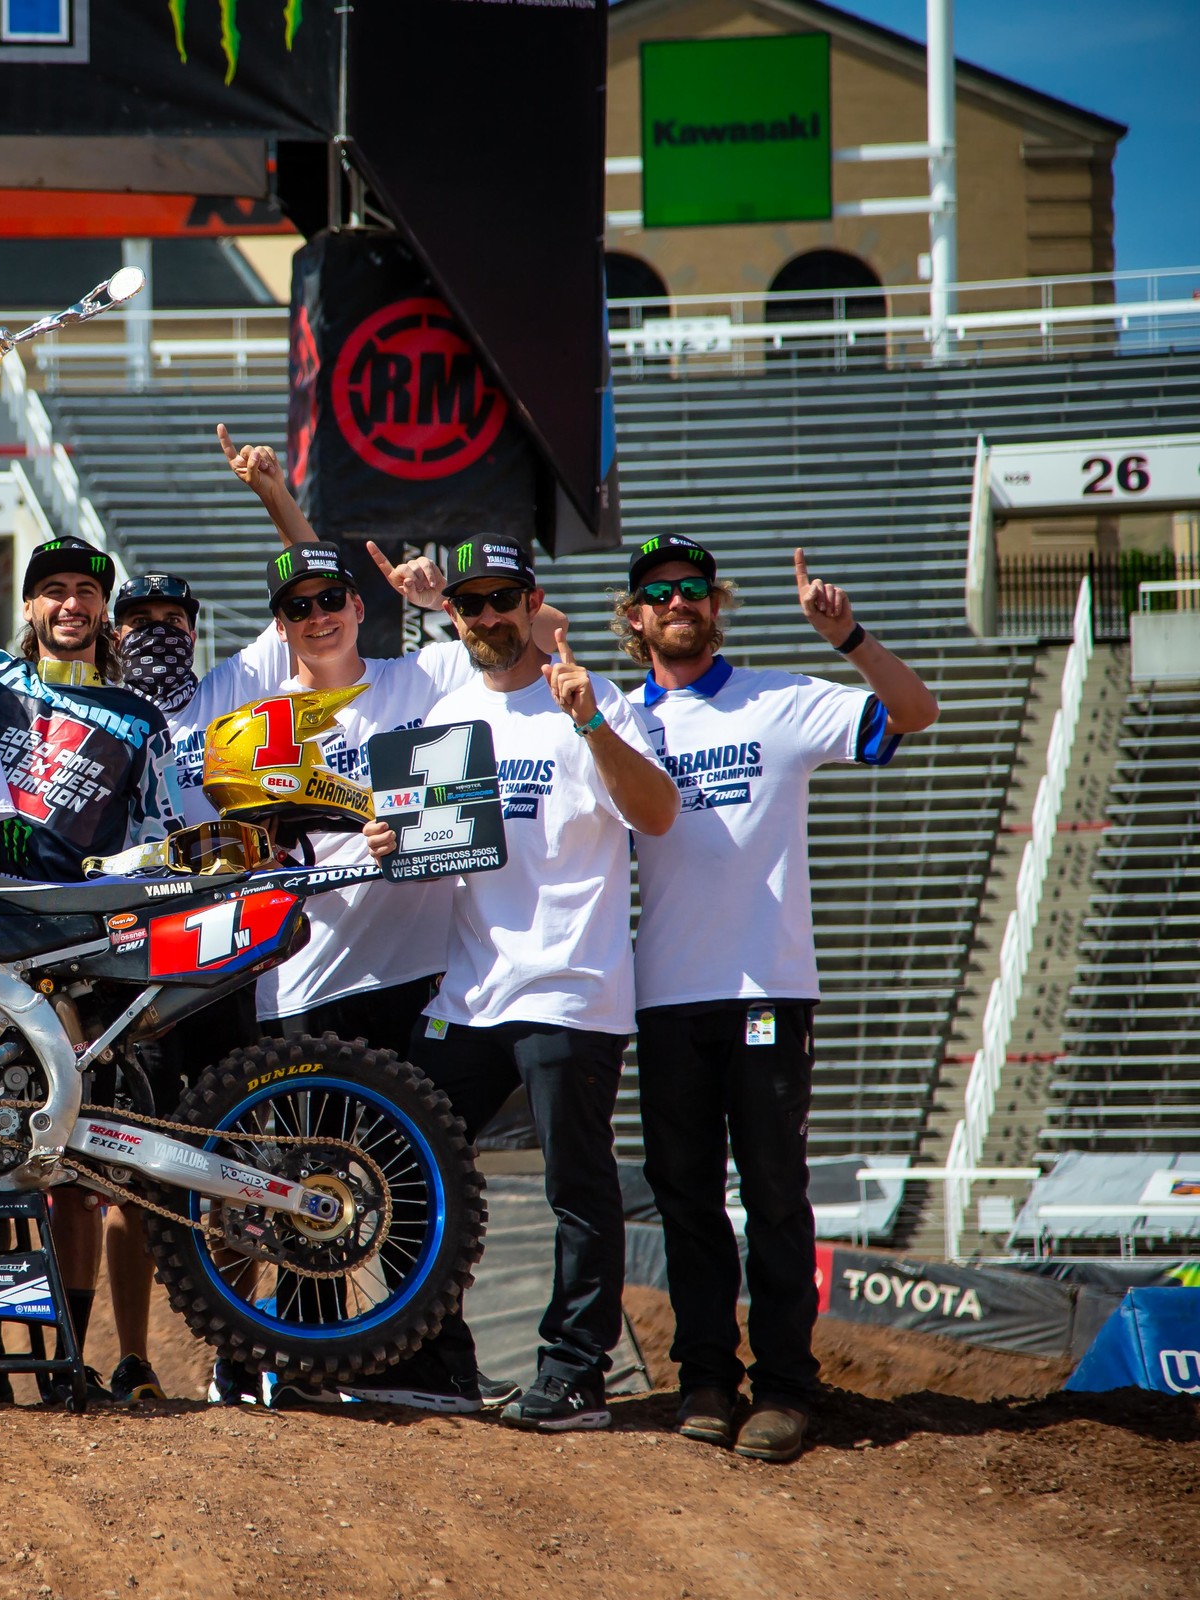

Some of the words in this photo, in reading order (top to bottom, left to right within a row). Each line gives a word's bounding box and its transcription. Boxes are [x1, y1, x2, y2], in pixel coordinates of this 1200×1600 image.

[653, 112, 821, 147] Kawasaki
[369, 352, 476, 426] RM
[1081, 455, 1150, 494] 26
[310, 550, 337, 559] YAMAHA
[492, 545, 518, 557] YAMAHA
[252, 697, 304, 771] 1
[0, 726, 57, 758] 2020
[54, 748, 106, 780] AMA
[324, 741, 348, 754] DYLAN
[176, 755, 188, 767] ST
[663, 741, 762, 777] RRANDIS
[17, 753, 51, 777] SX
[50, 766, 112, 802] WEST
[267, 776, 296, 788] BELL
[497, 759, 556, 783] ANDIS
[676, 774, 704, 788] WEST
[706, 766, 763, 784] CHAMPION
[4, 765, 89, 814] HAMPION
[381, 791, 421, 809] AMA
[504, 784, 554, 796] CHAMPION
[715, 788, 748, 801] THOR
[508, 803, 535, 813] THOR
[423, 829, 454, 842] 2020
[391, 857, 412, 868] AMA
[412, 850, 471, 865] SUPERCROSS
[472, 846, 498, 858] 250SX
[391, 864, 428, 878] WEST
[430, 854, 500, 873] CHAMPION
[306, 864, 382, 885] DUNL
[144, 881, 194, 897] YAMAHA
[111, 918, 126, 926] Twin
[185, 900, 242, 968] 1
[234, 928, 251, 950] W
[247, 1063, 324, 1092] DUNLOP
[87, 1123, 143, 1145] BRAKING
[89, 1135, 136, 1156] EXCEL
[154, 1141, 211, 1172] YAMALUBE
[220, 1163, 270, 1191] VORTEX
[842, 1268, 985, 1322] TOYOTA
[22, 1305, 51, 1313] YAMAHA
